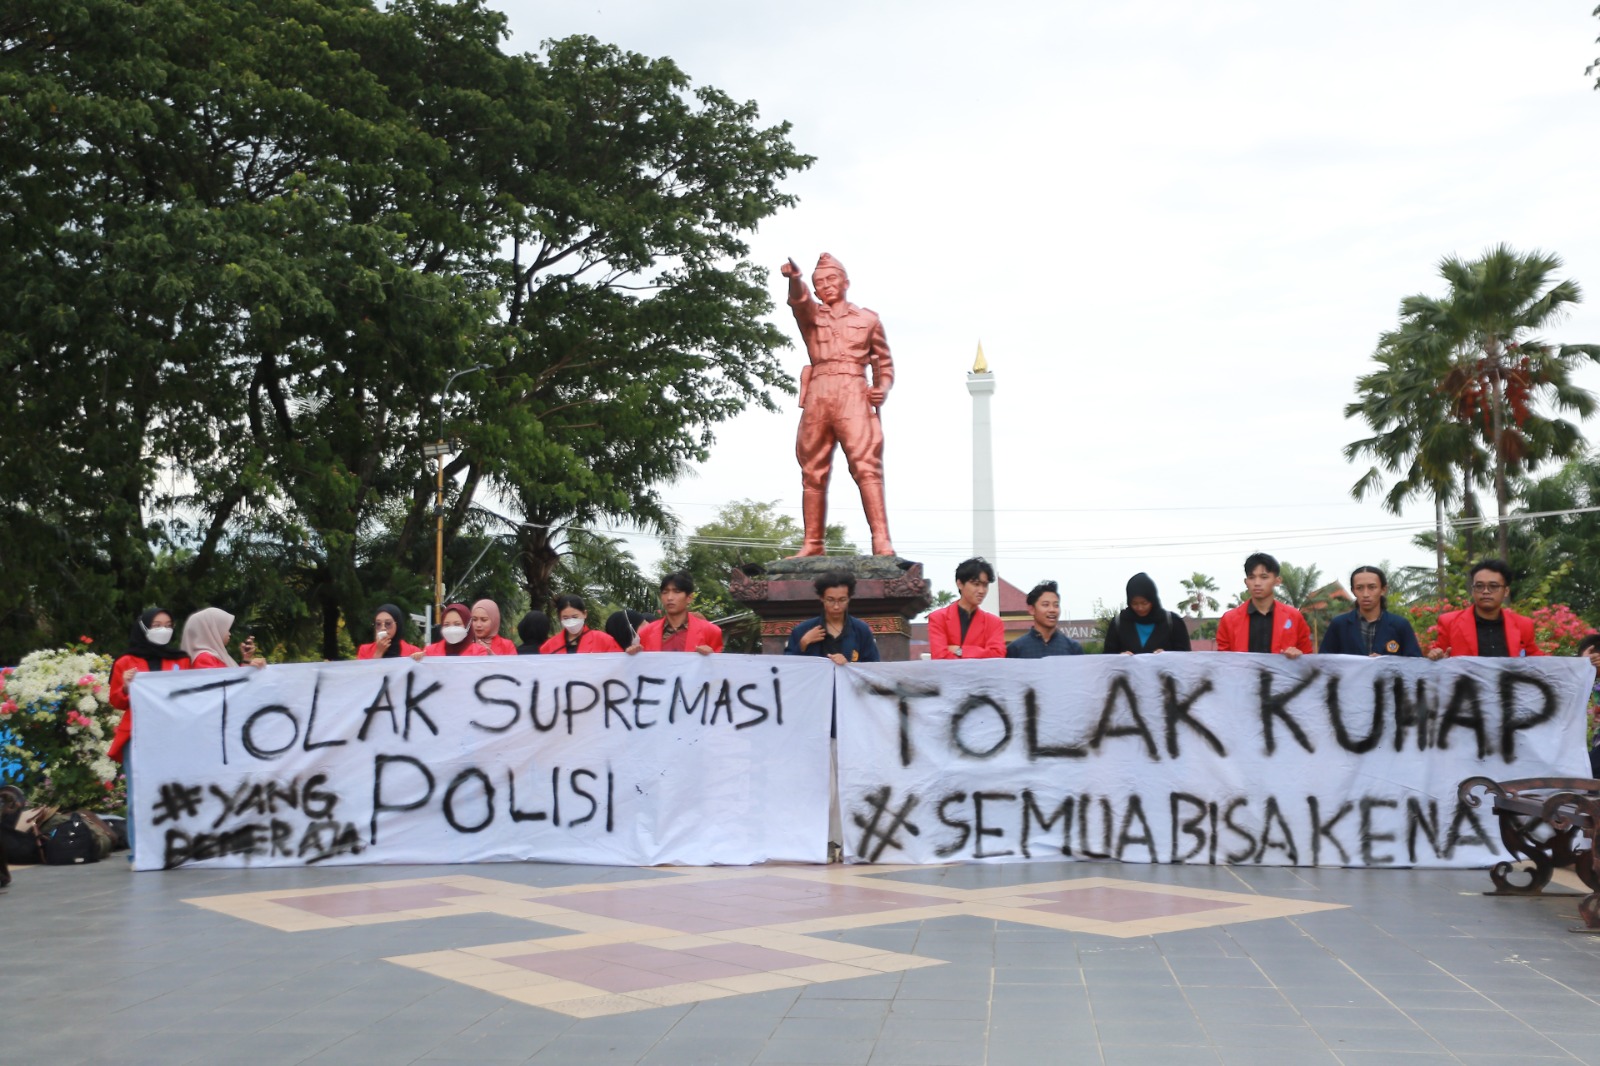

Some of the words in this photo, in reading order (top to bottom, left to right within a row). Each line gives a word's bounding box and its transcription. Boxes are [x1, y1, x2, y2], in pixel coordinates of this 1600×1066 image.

[169, 671, 443, 765] TOLAK
[864, 670, 1227, 766] TOLAK
[1257, 668, 1559, 764] KUHAP
[152, 774, 339, 829] #YANG
[370, 754, 614, 846] POLISI
